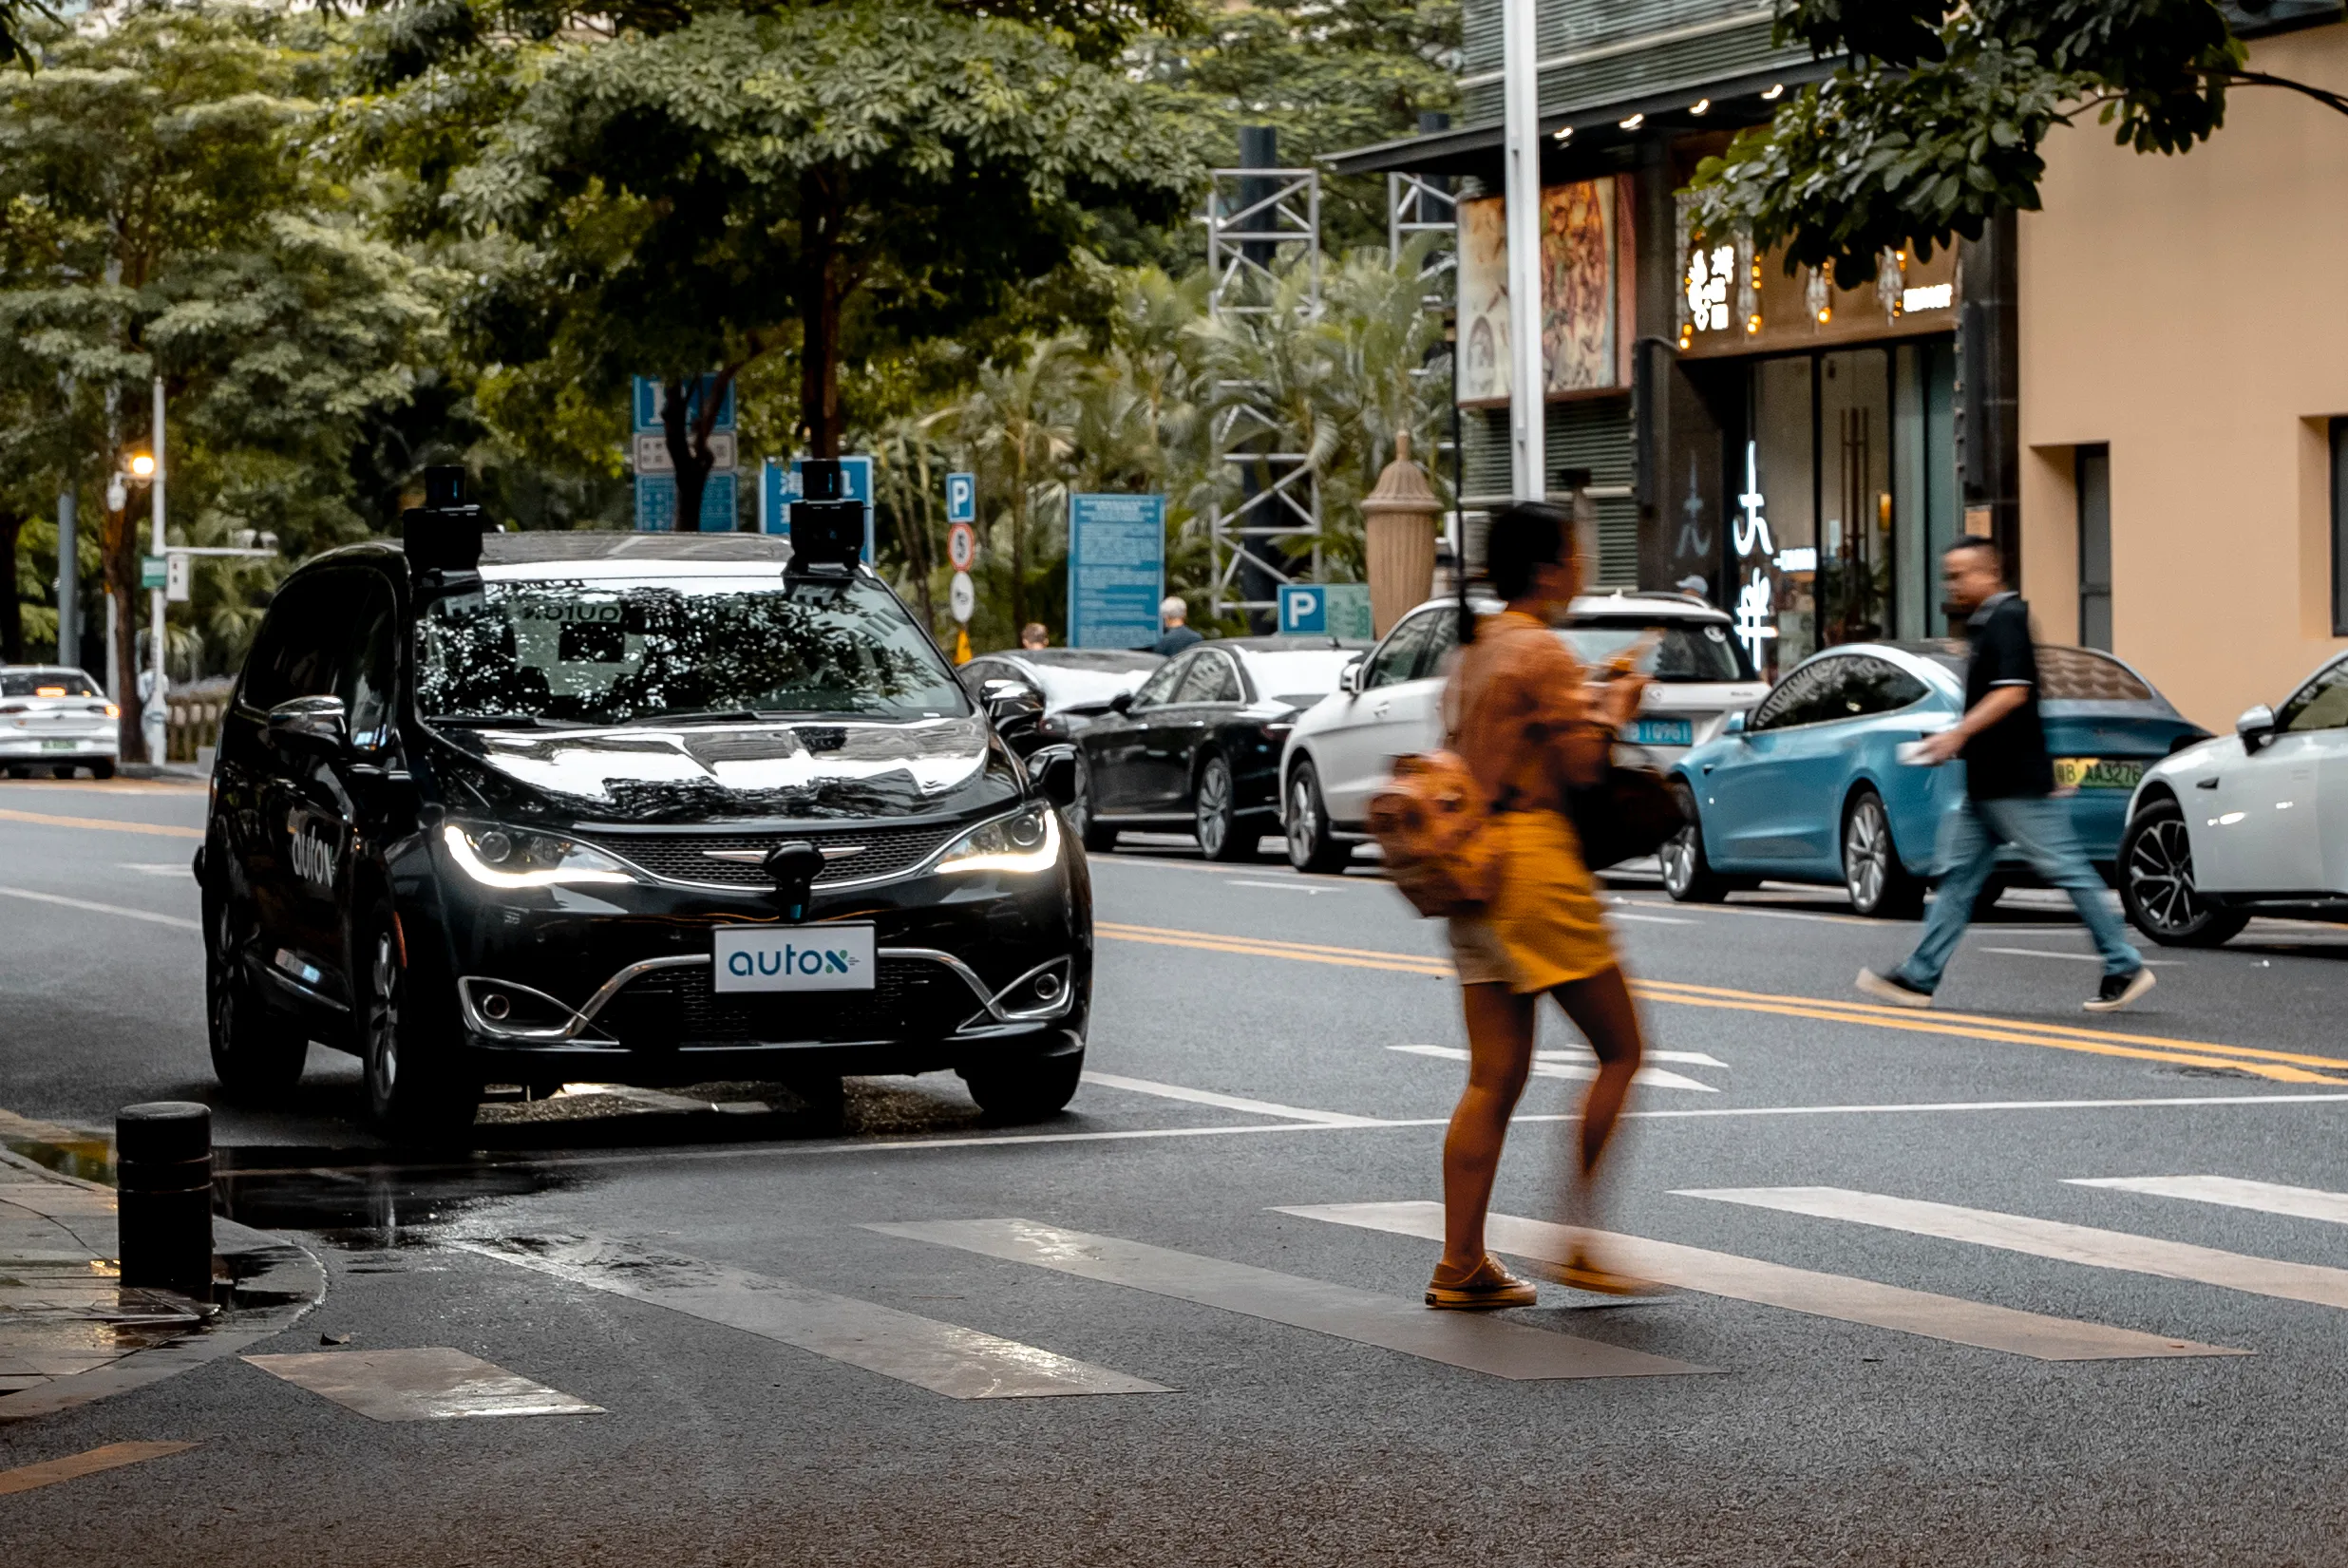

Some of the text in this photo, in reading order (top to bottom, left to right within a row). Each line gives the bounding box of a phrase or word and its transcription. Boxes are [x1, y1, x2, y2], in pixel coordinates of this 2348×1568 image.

[953, 480, 969, 516] P
[1288, 592, 1317, 628] P
[729, 943, 848, 976] autox
